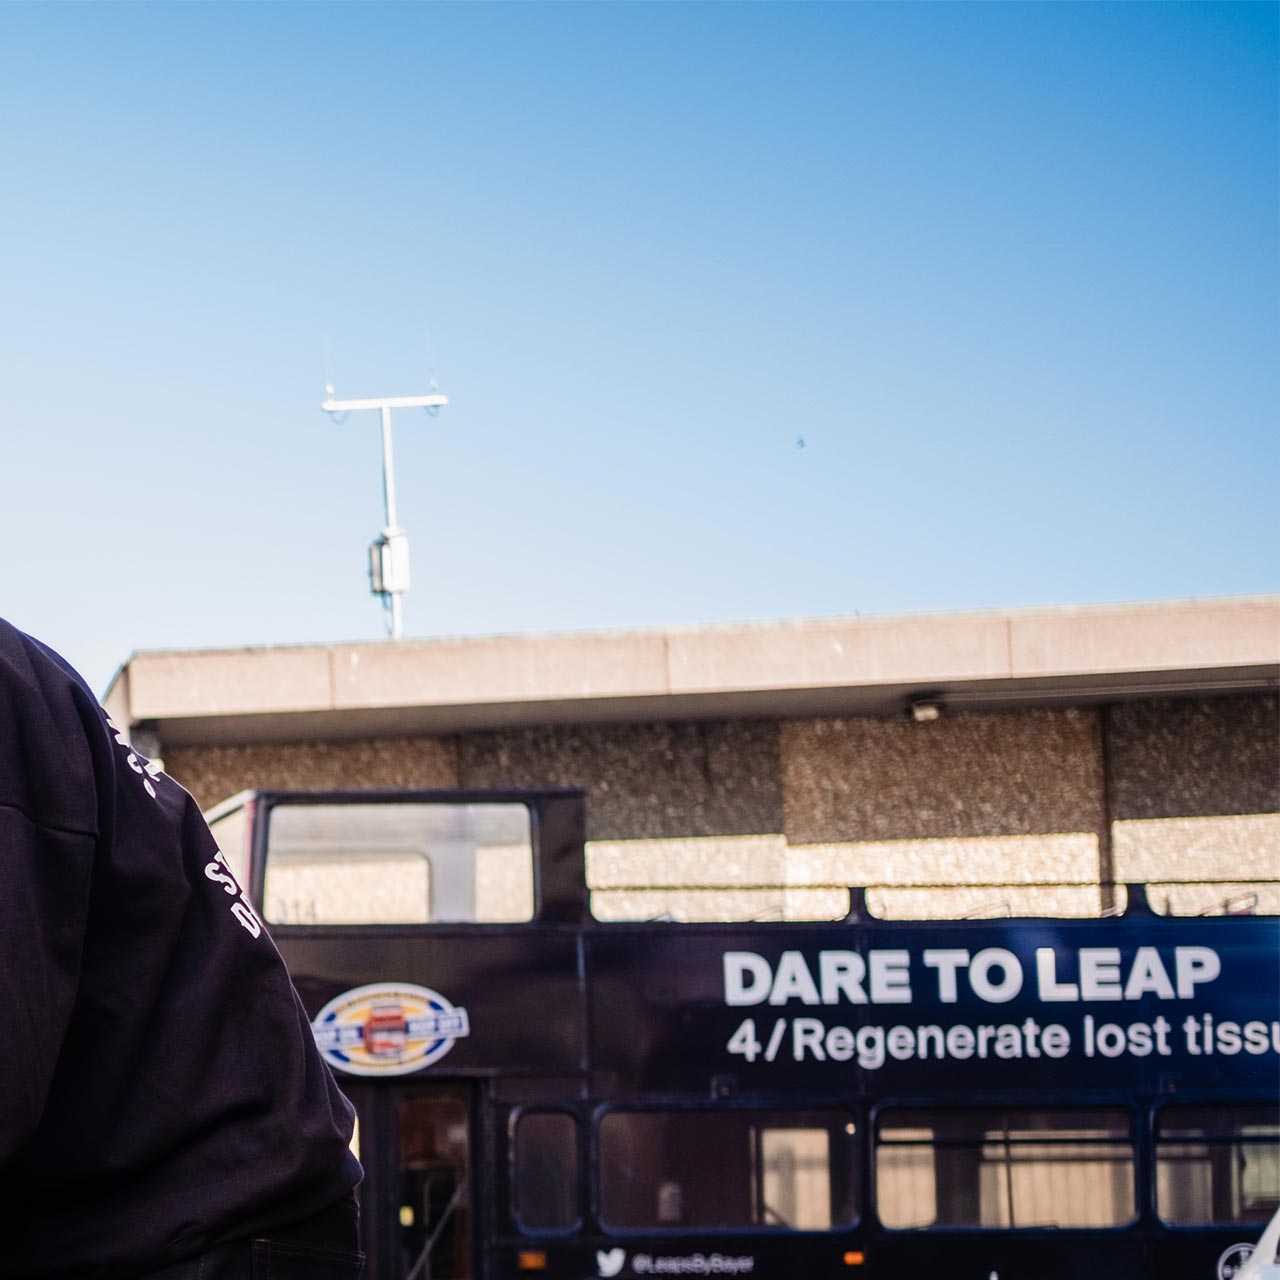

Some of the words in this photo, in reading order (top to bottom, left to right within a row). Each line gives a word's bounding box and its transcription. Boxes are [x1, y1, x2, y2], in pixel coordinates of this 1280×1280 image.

[723, 950, 912, 1006] DARE
[924, 947, 1024, 1003] TO
[1036, 946, 1222, 1002] LEAP
[727, 1017, 1071, 1070] 4/Regenerate
[1084, 1014, 1171, 1058] lost
